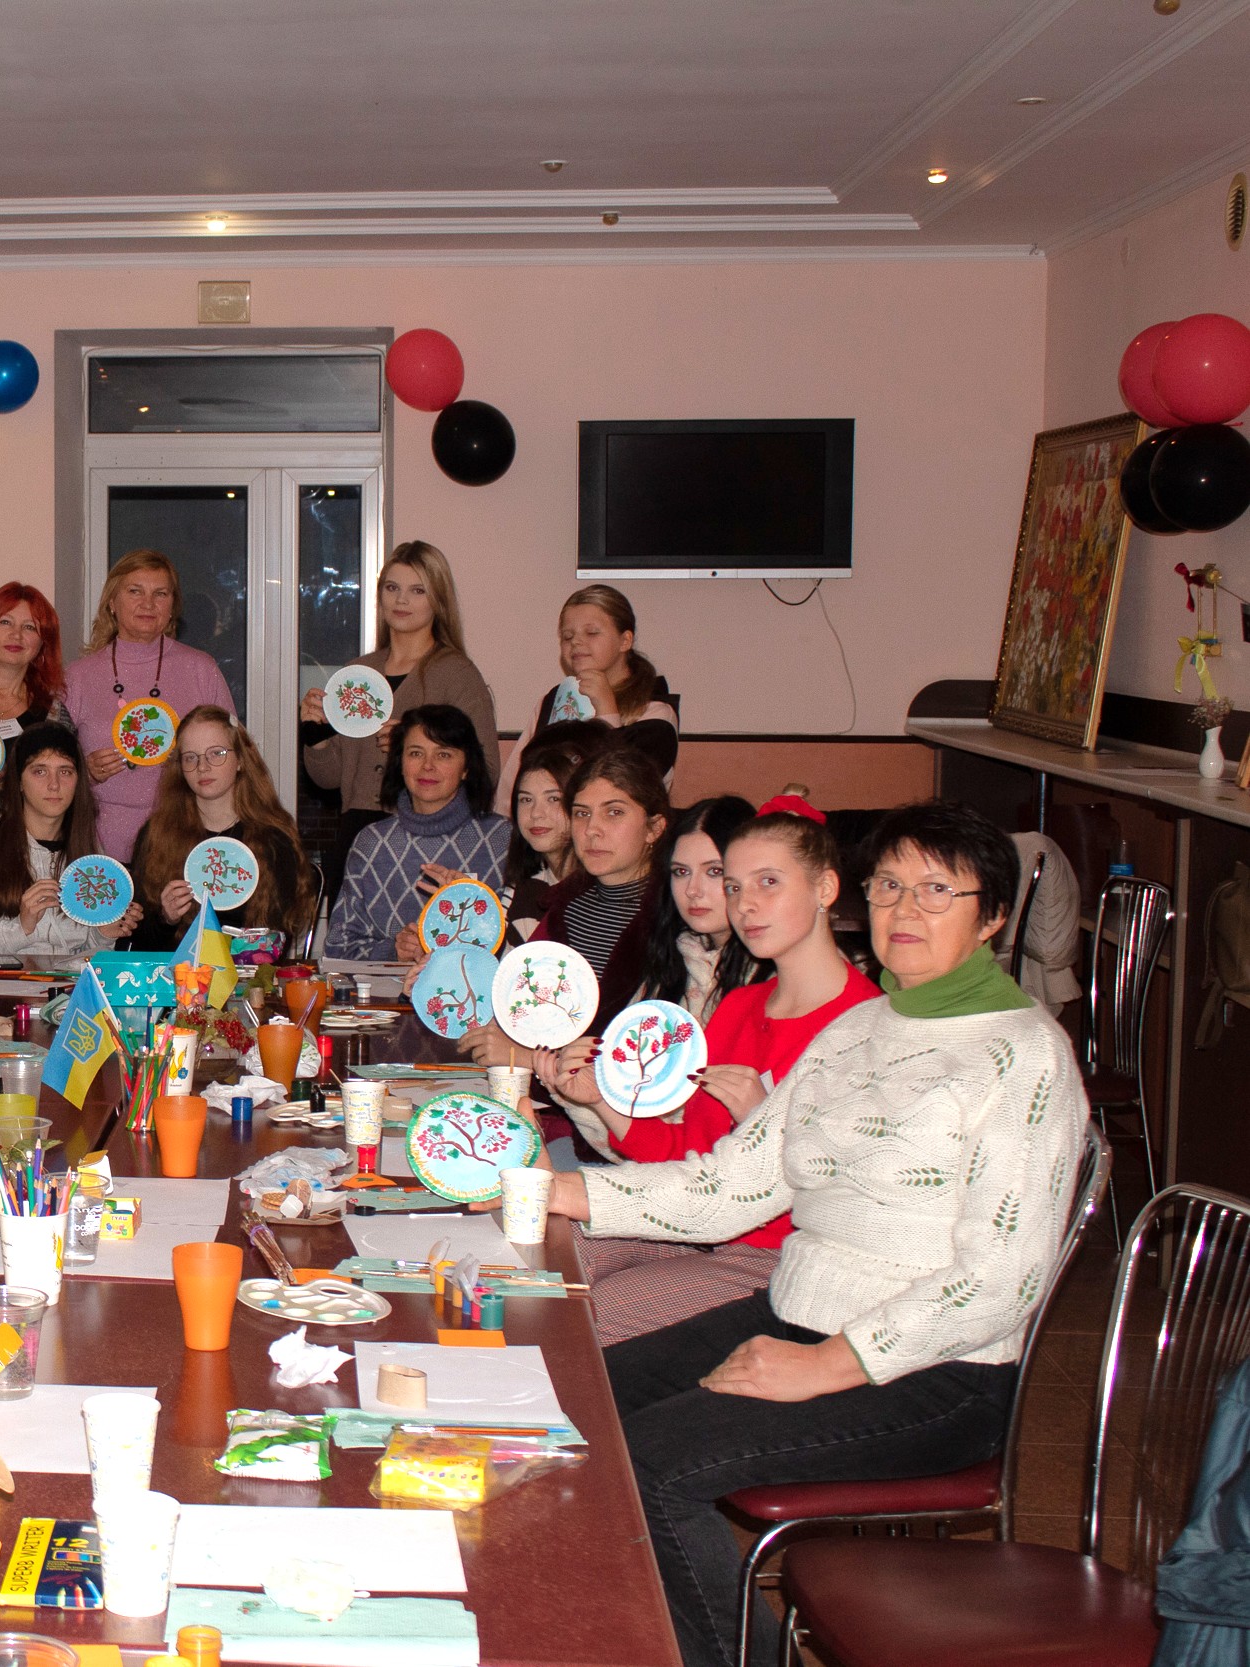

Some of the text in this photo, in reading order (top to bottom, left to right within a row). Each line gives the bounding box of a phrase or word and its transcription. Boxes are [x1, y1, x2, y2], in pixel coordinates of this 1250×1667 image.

[10, 1526, 45, 1592] SUPERB WRITER
[53, 1537, 90, 1548] 12
